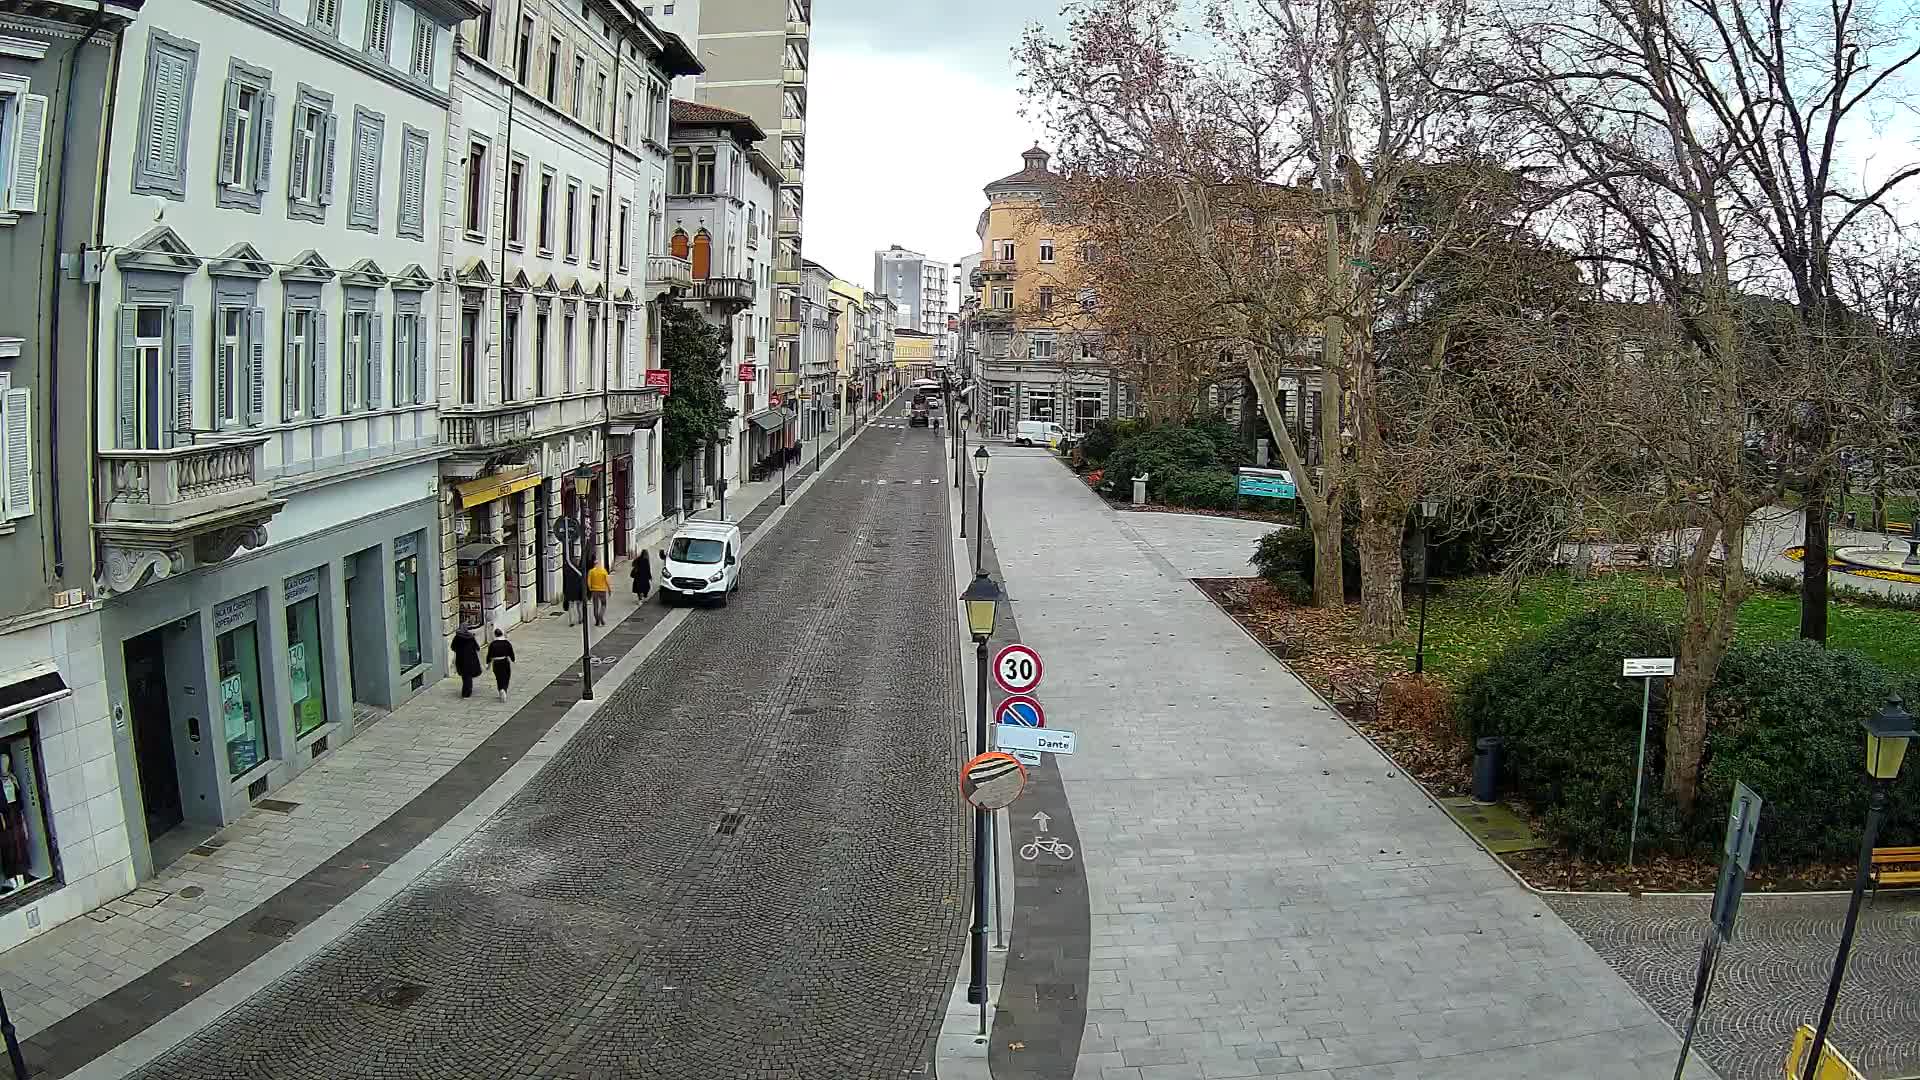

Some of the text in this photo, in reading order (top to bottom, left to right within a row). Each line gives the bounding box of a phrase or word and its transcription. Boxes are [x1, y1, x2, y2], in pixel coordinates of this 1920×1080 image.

[289, 645, 304, 666] 130
[1005, 659, 1033, 681] 30
[222, 677, 241, 700] 130
[1038, 738, 1070, 749] Dante
